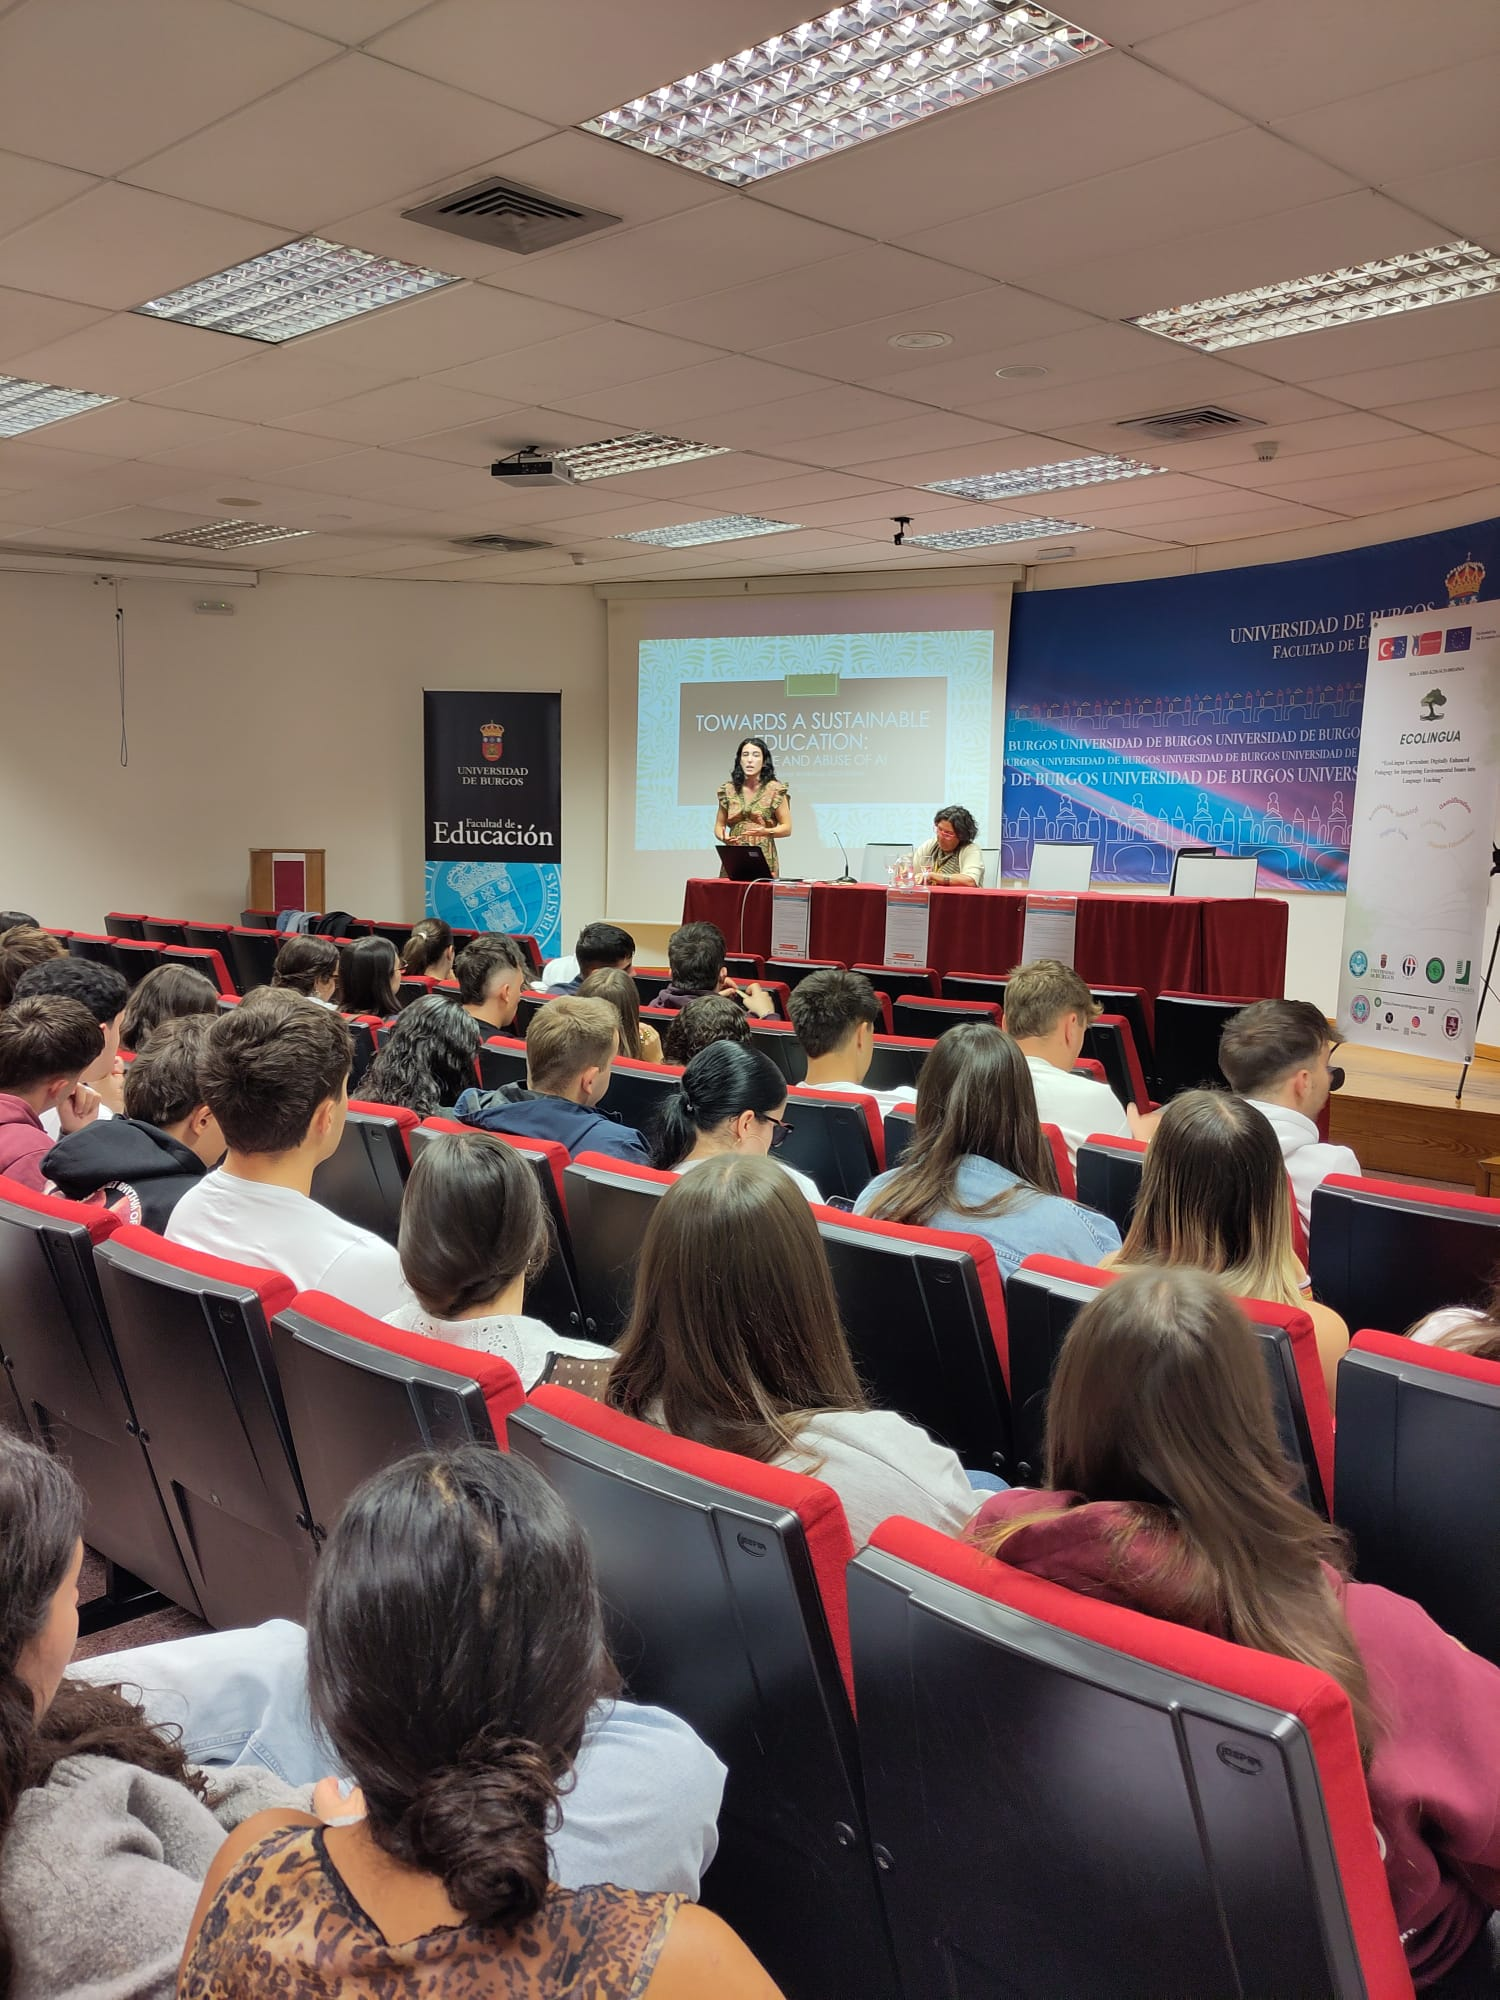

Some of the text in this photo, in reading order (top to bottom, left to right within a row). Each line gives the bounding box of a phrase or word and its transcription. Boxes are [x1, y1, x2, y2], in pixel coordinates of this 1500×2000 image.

[1230, 616, 1339, 644] UNIVERSIDAD
[1343, 612, 1365, 631] DE
[1272, 643, 1335, 660] FACULTAD
[1338, 639, 1354, 653] DE
[696, 710, 930, 732] TOWARDS A SUSTAINABLE
[755, 732, 868, 751] DUCATION:
[1008, 739, 1057, 751] BURGOS
[1060, 737, 1142, 750] UNIVERSIDAD
[1146, 736, 1161, 748] DE
[1164, 734, 1212, 747] BURGOS
[1215, 730, 1296, 745] UNIVERSIDAD
[1300, 729, 1315, 742] DE
[1400, 730, 1461, 745] ECOLINGUA
[782, 755, 809, 767] AND
[814, 755, 850, 766] ABUSE
[853, 754, 872, 766] OF
[1041, 756, 1105, 766] UNIVERSIDAD
[1107, 755, 1120, 765] DE
[1122, 755, 1160, 765] BURGOS
[1162, 753, 1223, 764] UNIVERSIDAD
[1225, 753, 1238, 762] DE
[1240, 751, 1280, 762] BURGOS
[1281, 749, 1342, 761] UNIVERSIDAD
[1344, 748, 1357, 758] DE
[457, 766, 528, 776] UNIVERSIDAD
[1011, 773, 1031, 786] DE
[1034, 772, 1098, 786] BURGOS
[1102, 770, 1201, 785] UNIVERSIDAD
[1206, 769, 1227, 785] DE
[1231, 768, 1294, 784] BURGOS
[462, 776, 524, 786] DE BURGOS
[466, 818, 515, 829] Facultad de
[432, 820, 554, 846] Educación
